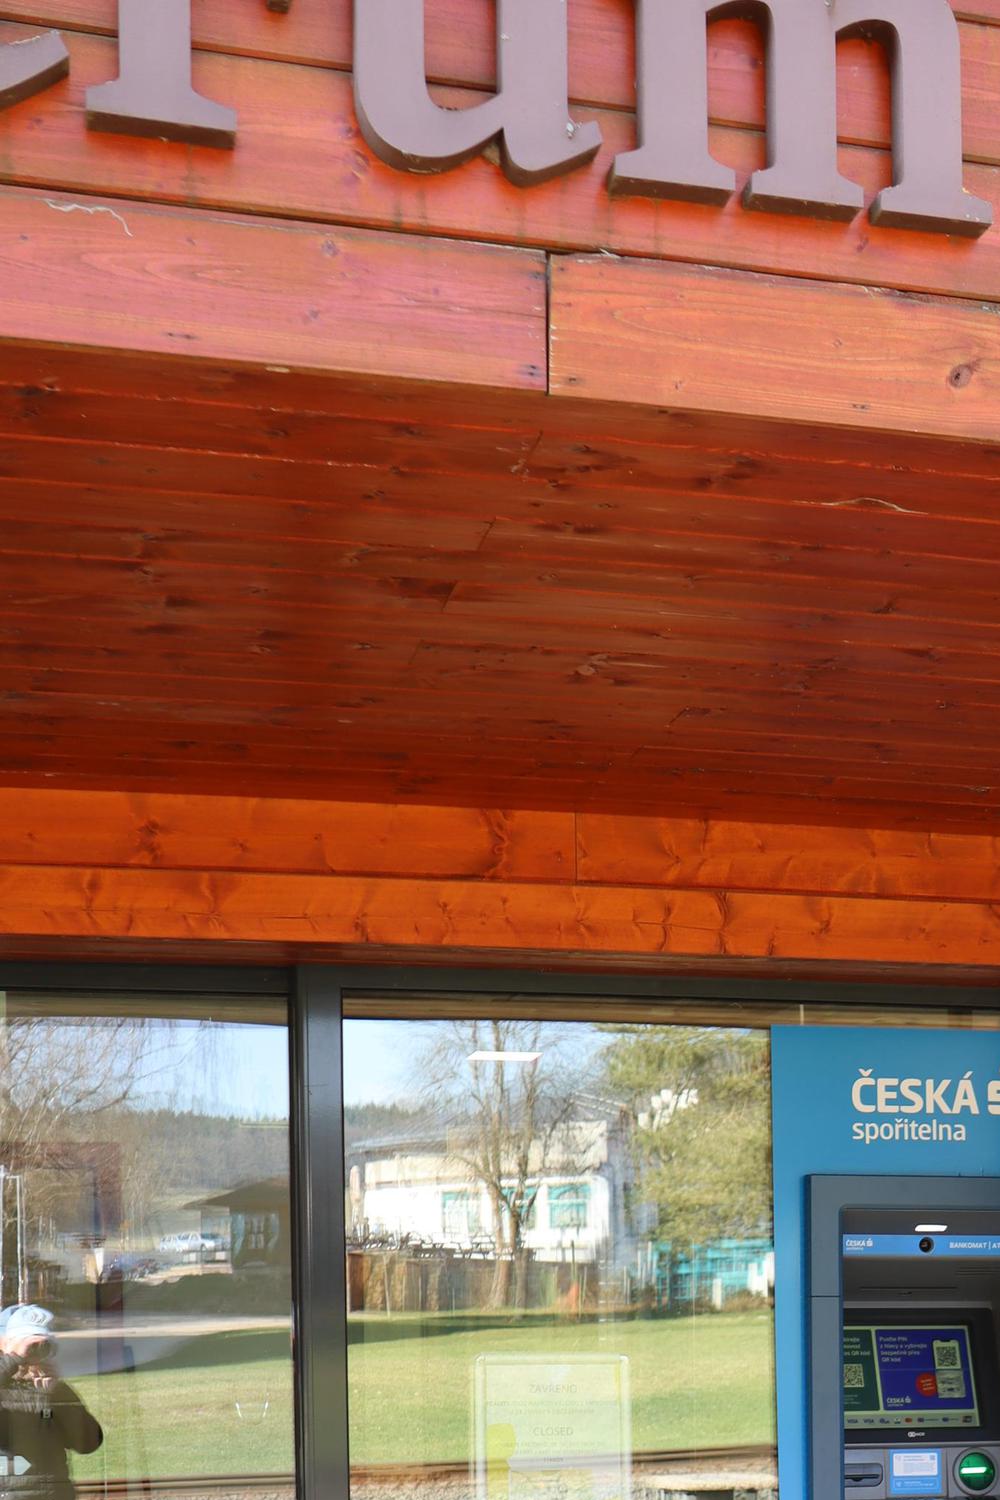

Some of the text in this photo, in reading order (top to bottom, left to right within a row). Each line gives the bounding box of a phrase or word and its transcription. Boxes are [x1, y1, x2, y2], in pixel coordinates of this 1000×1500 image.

[852, 1068, 980, 1115] ČESKÁ
[852, 1118, 966, 1144] spořitelna
[949, 1241, 988, 1249] BANKOMAT
[533, 1426, 574, 1437] CLOSED
